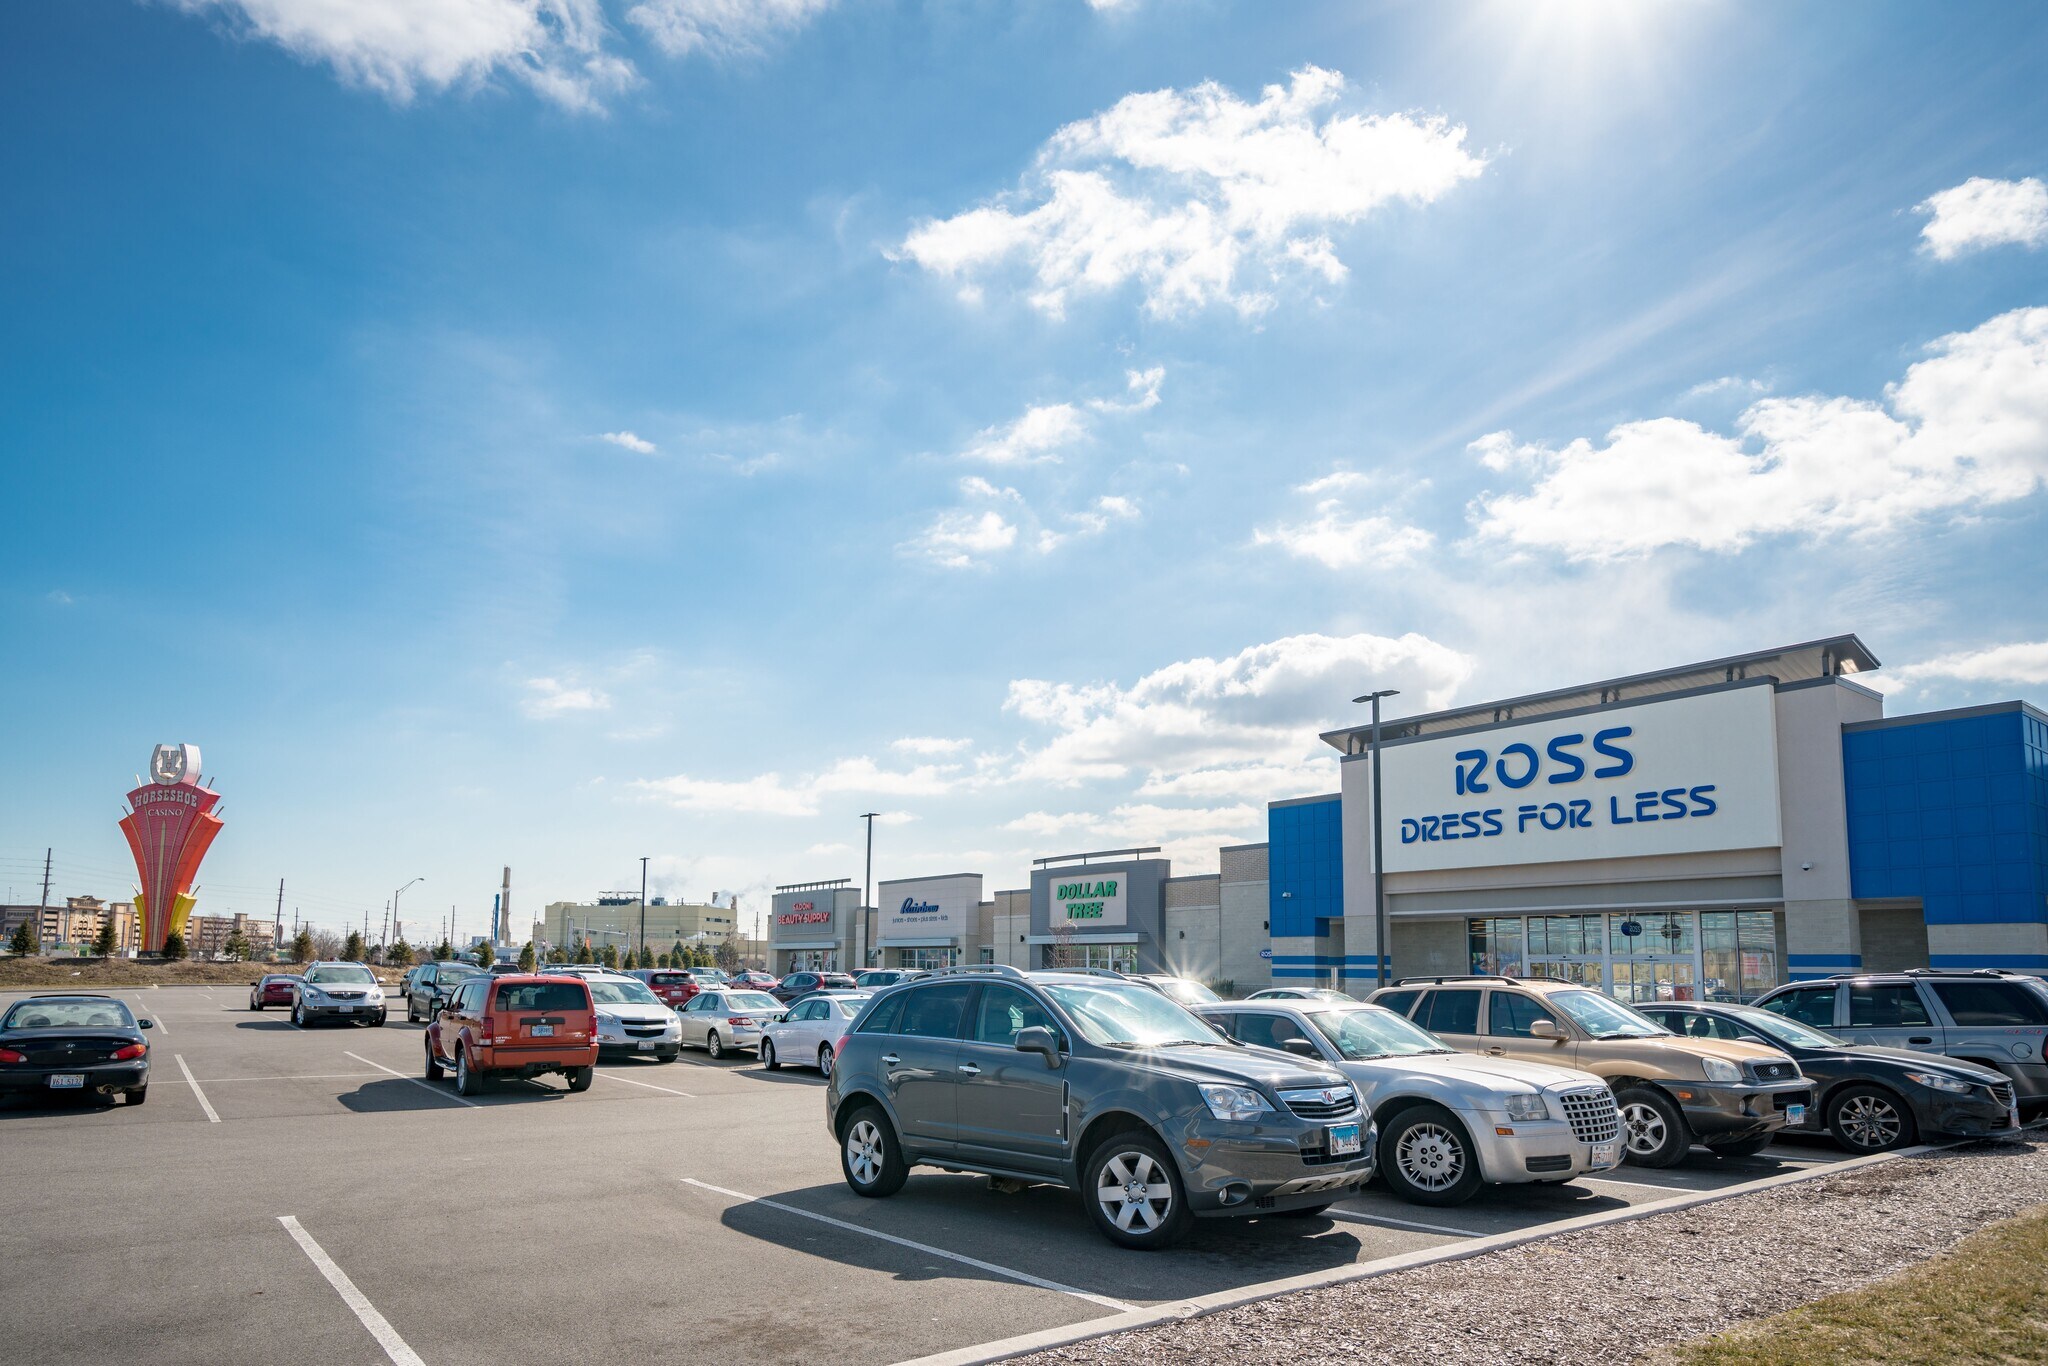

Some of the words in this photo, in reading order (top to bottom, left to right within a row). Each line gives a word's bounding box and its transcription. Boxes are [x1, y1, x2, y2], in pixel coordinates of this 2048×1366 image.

[1455, 726, 1634, 795] ROSS
[134, 789, 198, 808] HORSESHOE
[147, 808, 183, 817] CASINO
[1401, 808, 1503, 844] DRESS
[1518, 799, 1592, 833] FOR
[1610, 784, 1717, 824] LESS
[1056, 880, 1117, 900] DOLLAR
[900, 897, 939, 914] Rainbow
[1066, 901, 1104, 919] TREE
[777, 913, 803, 925] BEAUTY
[803, 912, 830, 923] SUPPLY
[1629, 925, 1641, 933] ROSS
